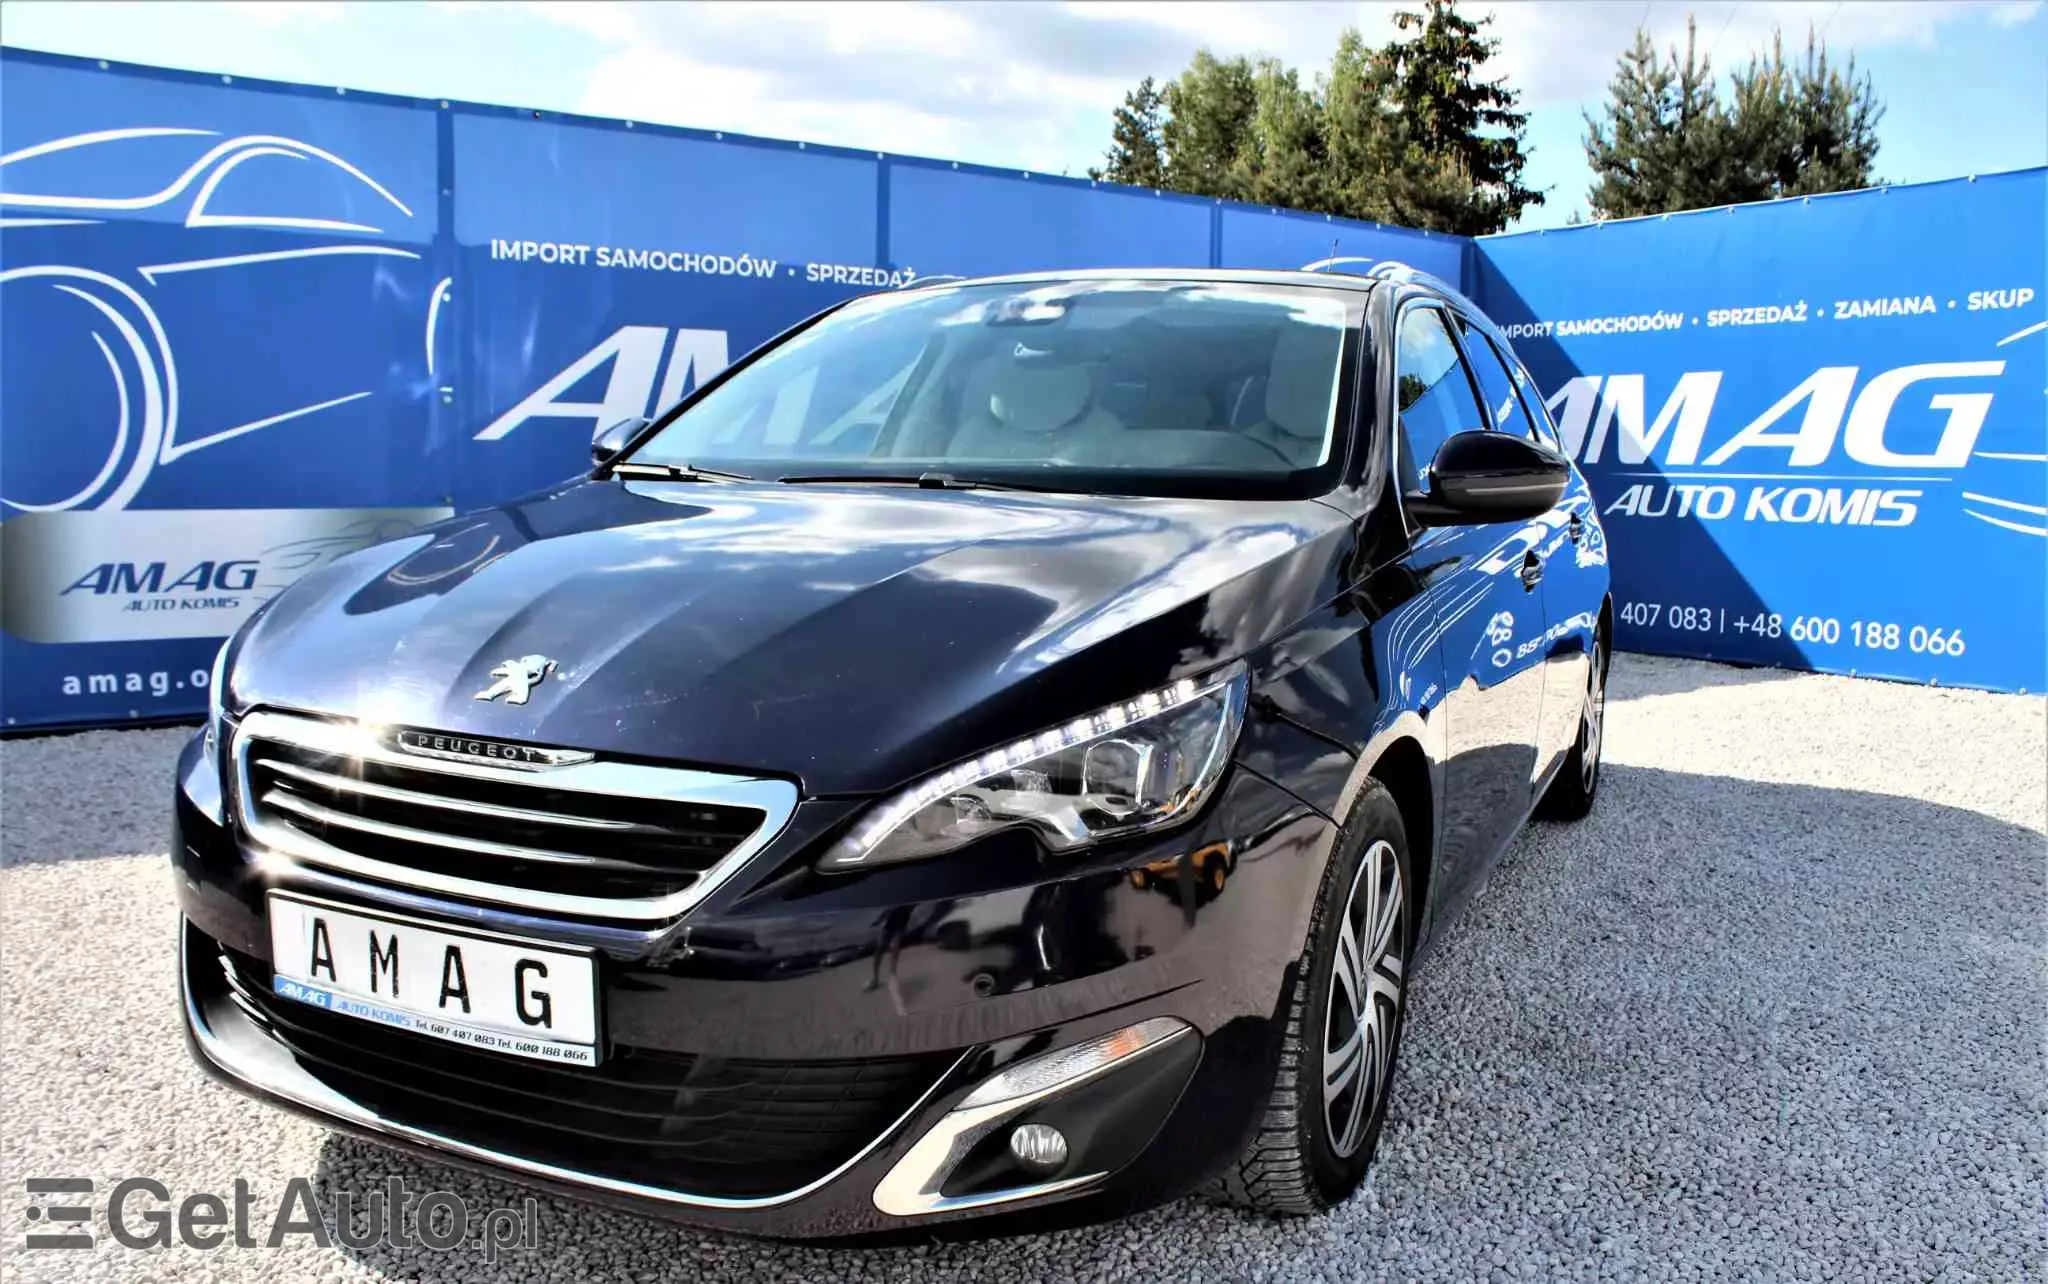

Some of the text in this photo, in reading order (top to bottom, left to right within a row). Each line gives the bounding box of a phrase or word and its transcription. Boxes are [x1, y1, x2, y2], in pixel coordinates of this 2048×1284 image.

[491, 239, 916, 289] IMPORT SAMOCHODÓW SPRZEDAŻ
[1556, 310, 1684, 337] SAMOCHODÓW
[1707, 300, 1808, 327] SPRZEDAŻ
[1834, 295, 1937, 320] ZAMIANA
[1967, 287, 2035, 311] SKUP
[1604, 484, 1923, 527] AUTO KOMIS
[123, 597, 240, 612] AUTO KOMIS
[1621, 602, 1966, 657] 407 083 +48 600 188 066
[418, 735, 535, 761] PEUGEOT
[337, 1001, 369, 1016] AUTO
[371, 1008, 411, 1026] KOMIS
[431, 1024, 450, 1035] 607
[452, 1029, 472, 1040] 407
[474, 1034, 495, 1045] 083
[516, 1042, 540, 1053] 600
[542, 1046, 560, 1057] 188
[564, 1049, 588, 1061] 066
